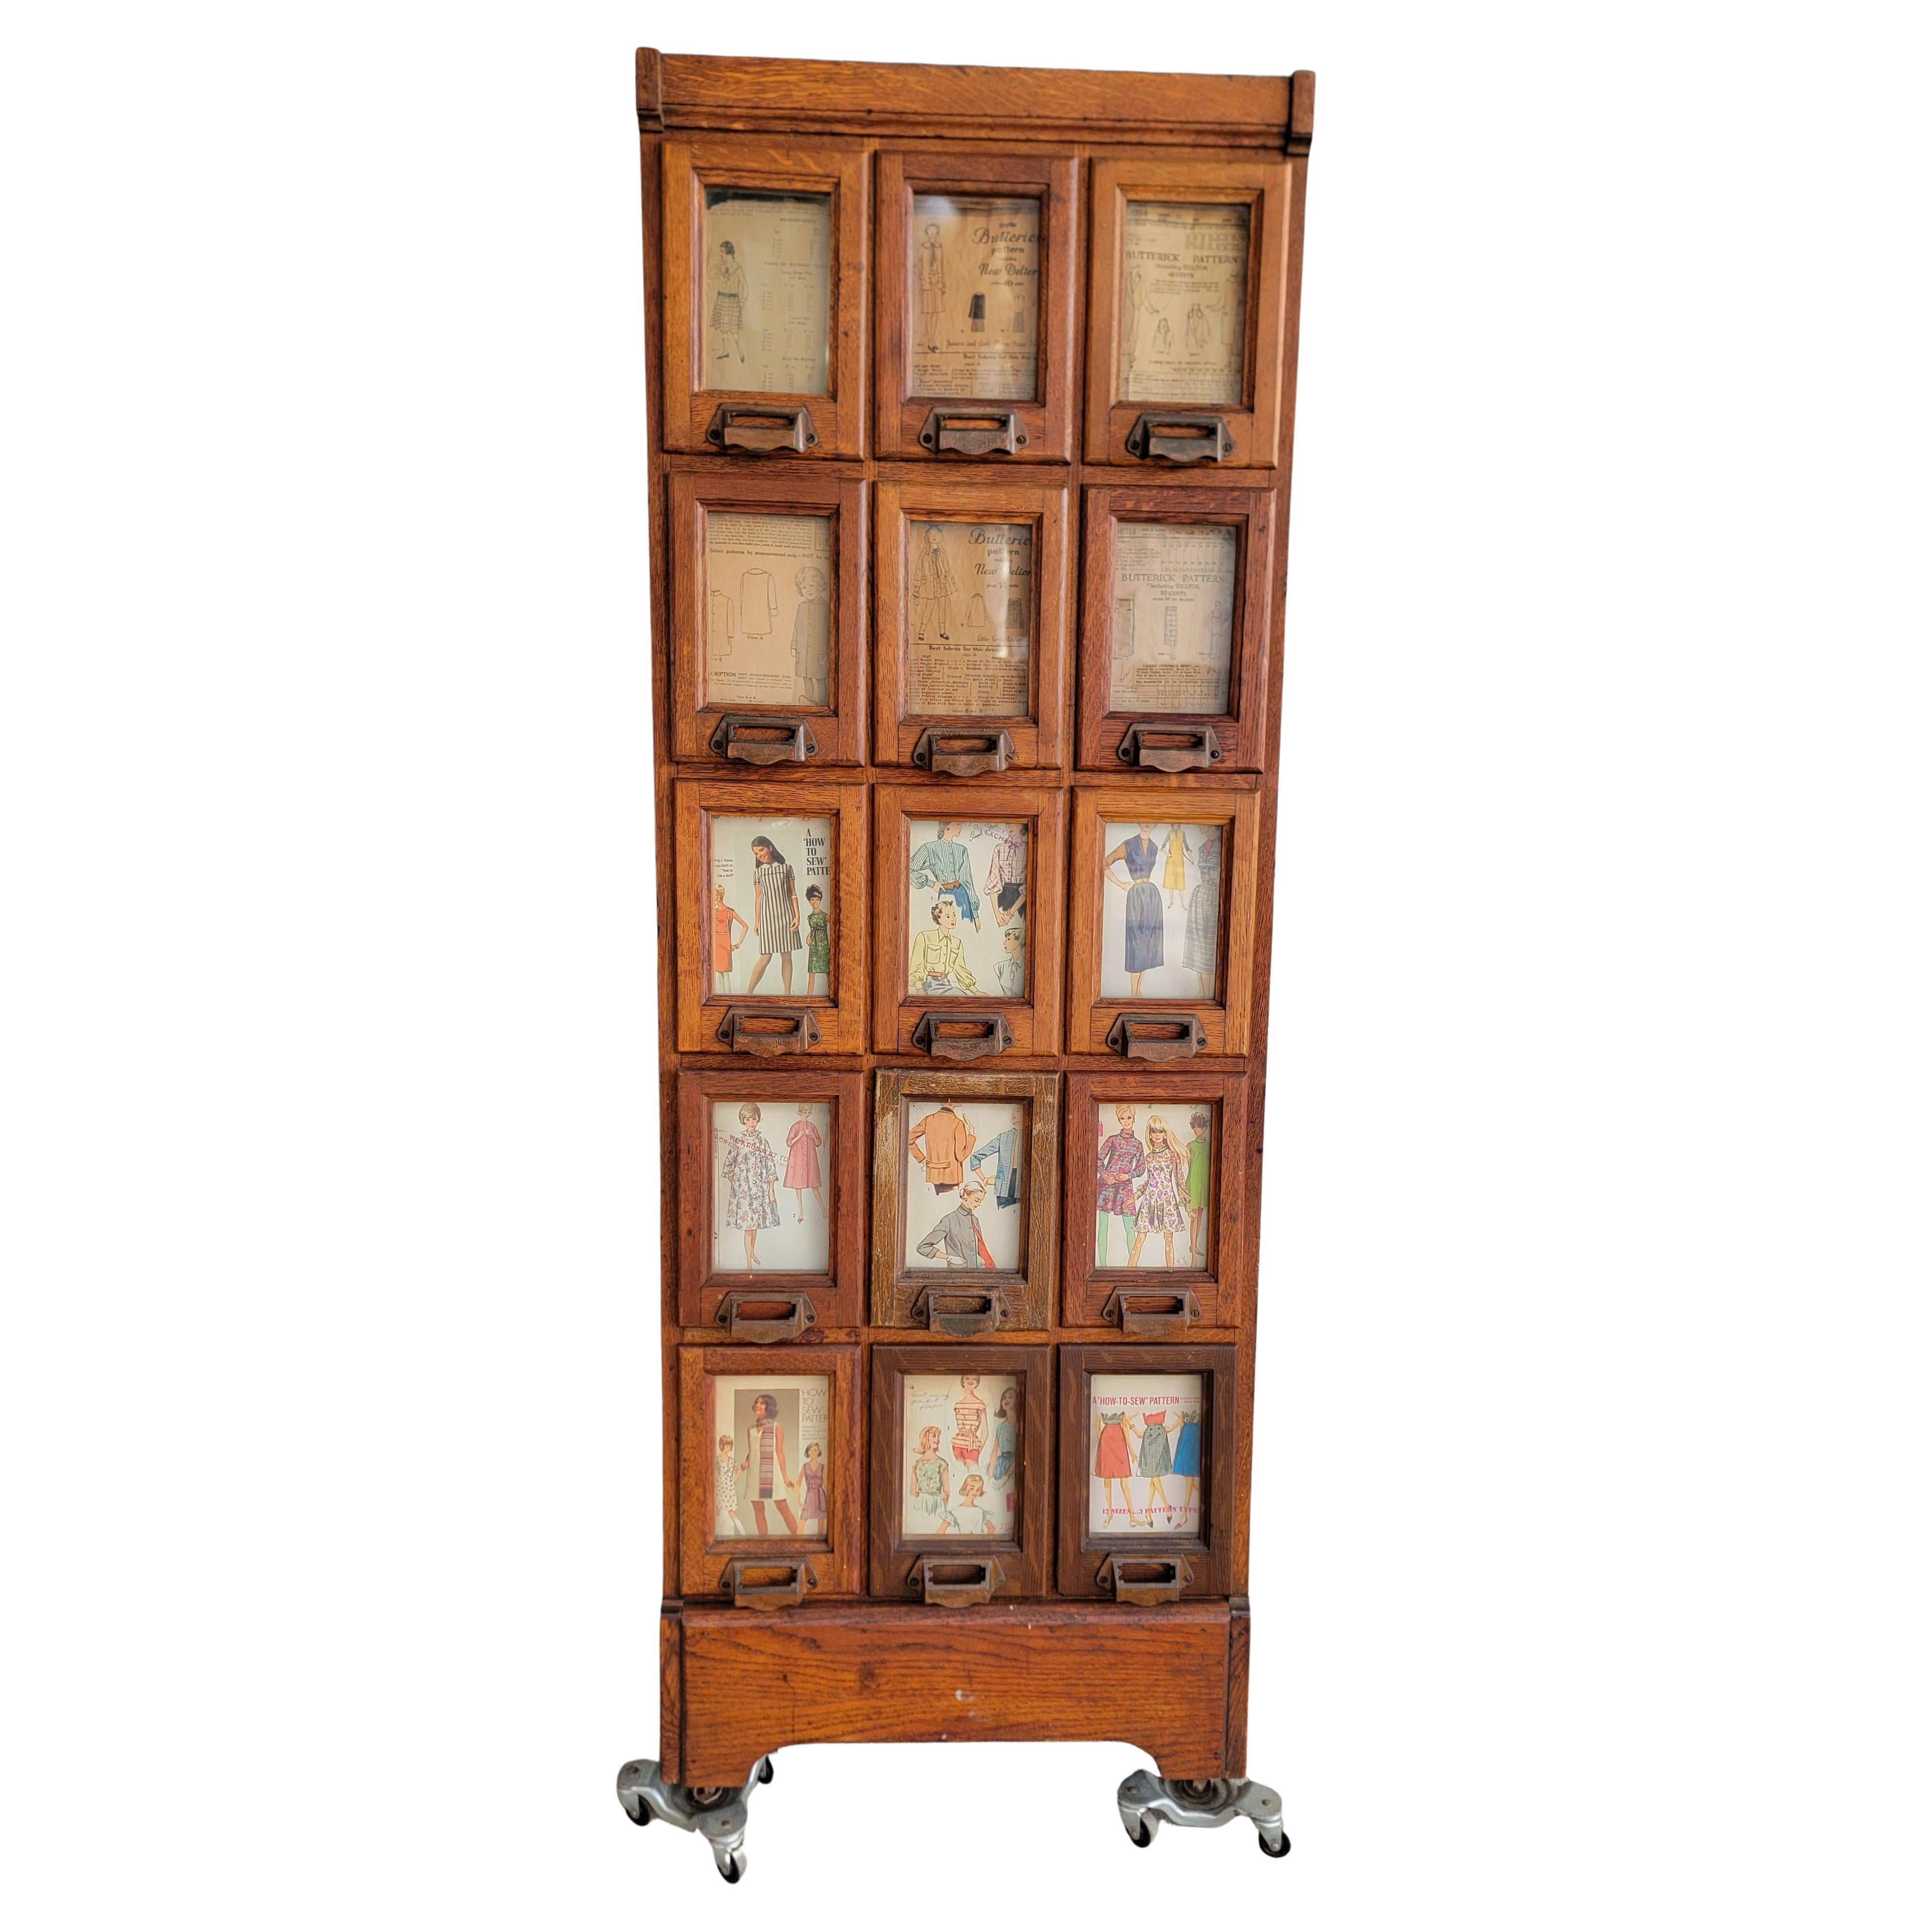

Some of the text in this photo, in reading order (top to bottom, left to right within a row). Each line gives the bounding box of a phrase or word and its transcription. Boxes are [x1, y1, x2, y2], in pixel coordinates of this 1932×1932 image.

[974, 563, 998, 575] New
[1122, 574, 1176, 582] BUTTERICK
[806, 828, 812, 837] A
[803, 837, 826, 847] 'HOW
[806, 847, 817, 856] TO
[806, 856, 827, 865] SEW'
[806, 866, 831, 876] PATTE
[802, 1398, 813, 1406] TO
[1092, 1396, 1180, 1406] A "HOW-TO-SEW" PATTERN
[802, 1414, 828, 1423] PATTER
[1145, 1506, 1177, 1515] PATTERN
